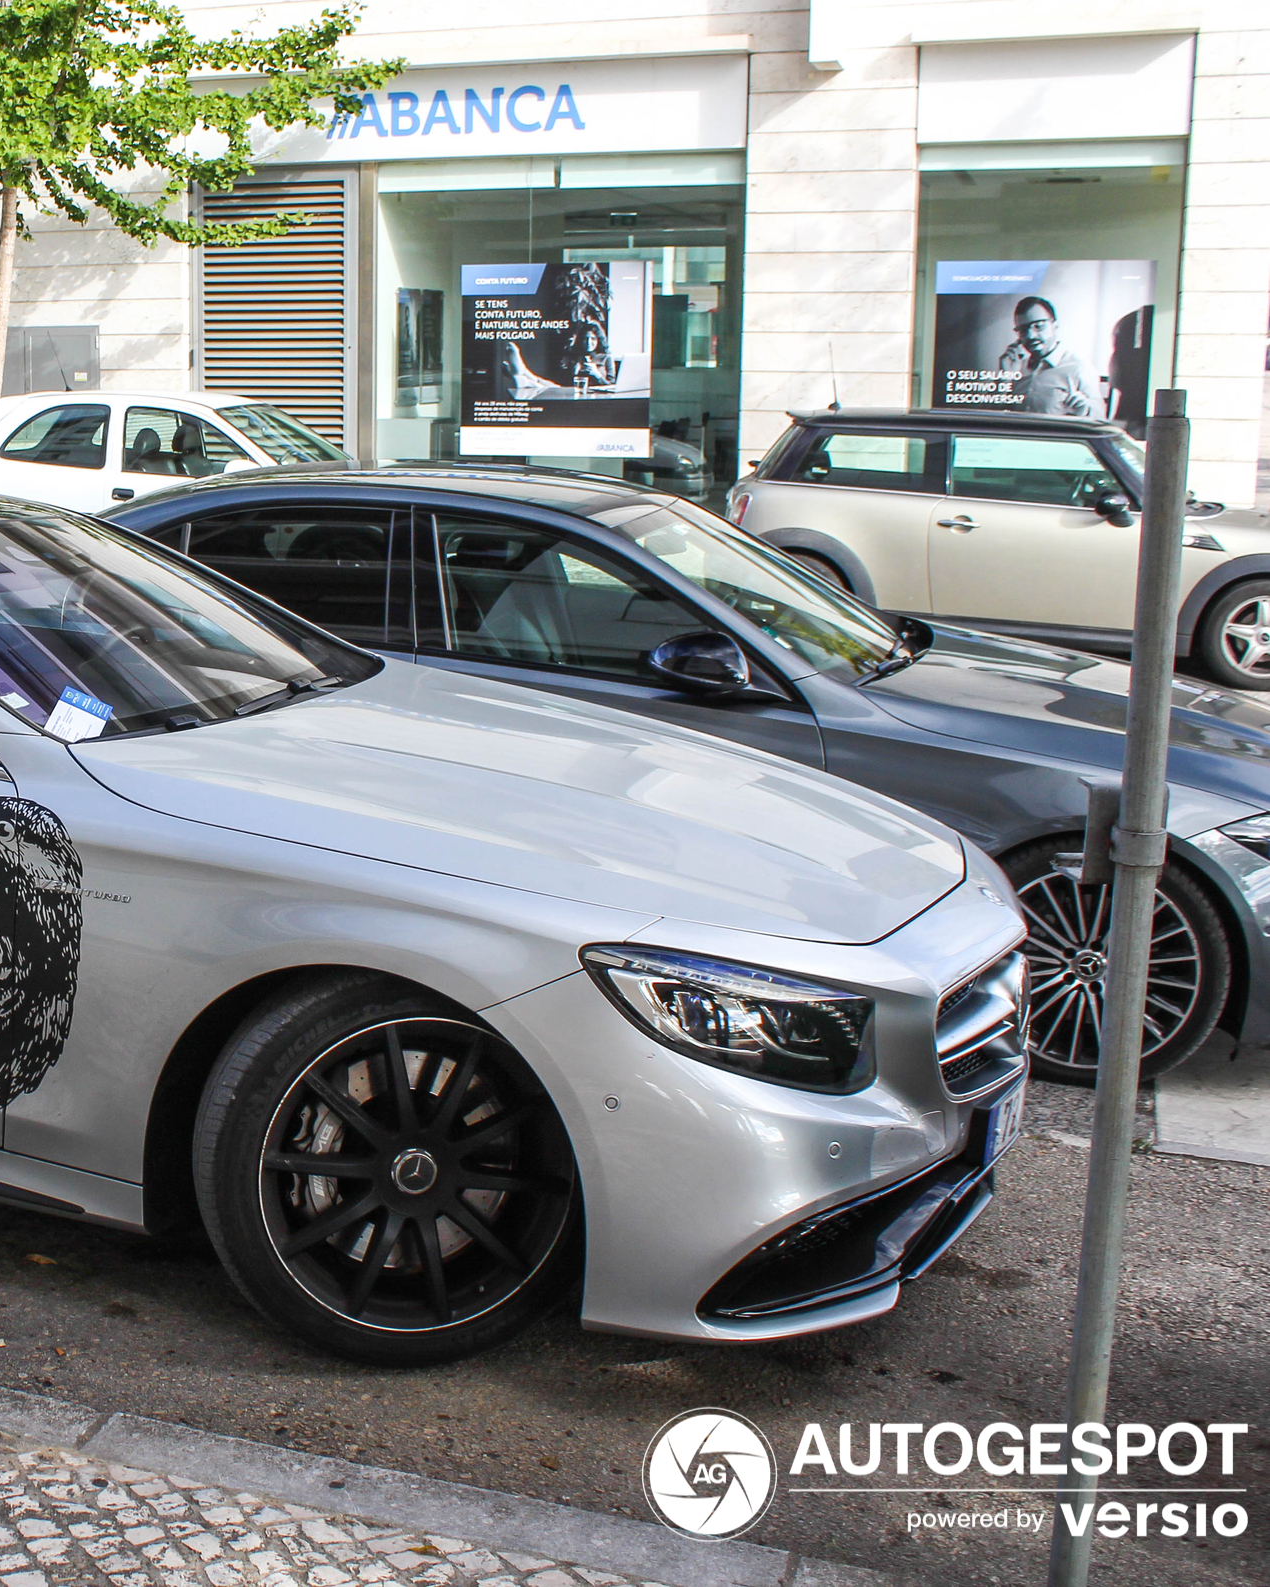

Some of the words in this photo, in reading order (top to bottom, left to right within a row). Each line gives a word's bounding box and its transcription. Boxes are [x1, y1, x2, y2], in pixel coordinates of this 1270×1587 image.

[349, 84, 585, 139] ABANCA
[475, 300, 485, 308] SE
[487, 300, 508, 308] TENS
[475, 311, 505, 319] CONTA
[506, 310, 542, 320] FUTURO,
[475, 320, 480, 329] É
[482, 321, 519, 329] NATURAL
[521, 321, 539, 329] QUE
[541, 321, 569, 329] ANDES
[475, 331, 494, 340] MAIS
[496, 331, 535, 340] FOLGADA
[946, 371, 956, 380] O
[958, 371, 977, 380] SEU
[979, 369, 1022, 380] SALÁRIO
[946, 381, 953, 391] É
[955, 382, 997, 391] MOTIVO
[999, 382, 1013, 391] DE
[945, 394, 1025, 404] DESCONVERSA?
[598, 444, 634, 452] ABANCA
